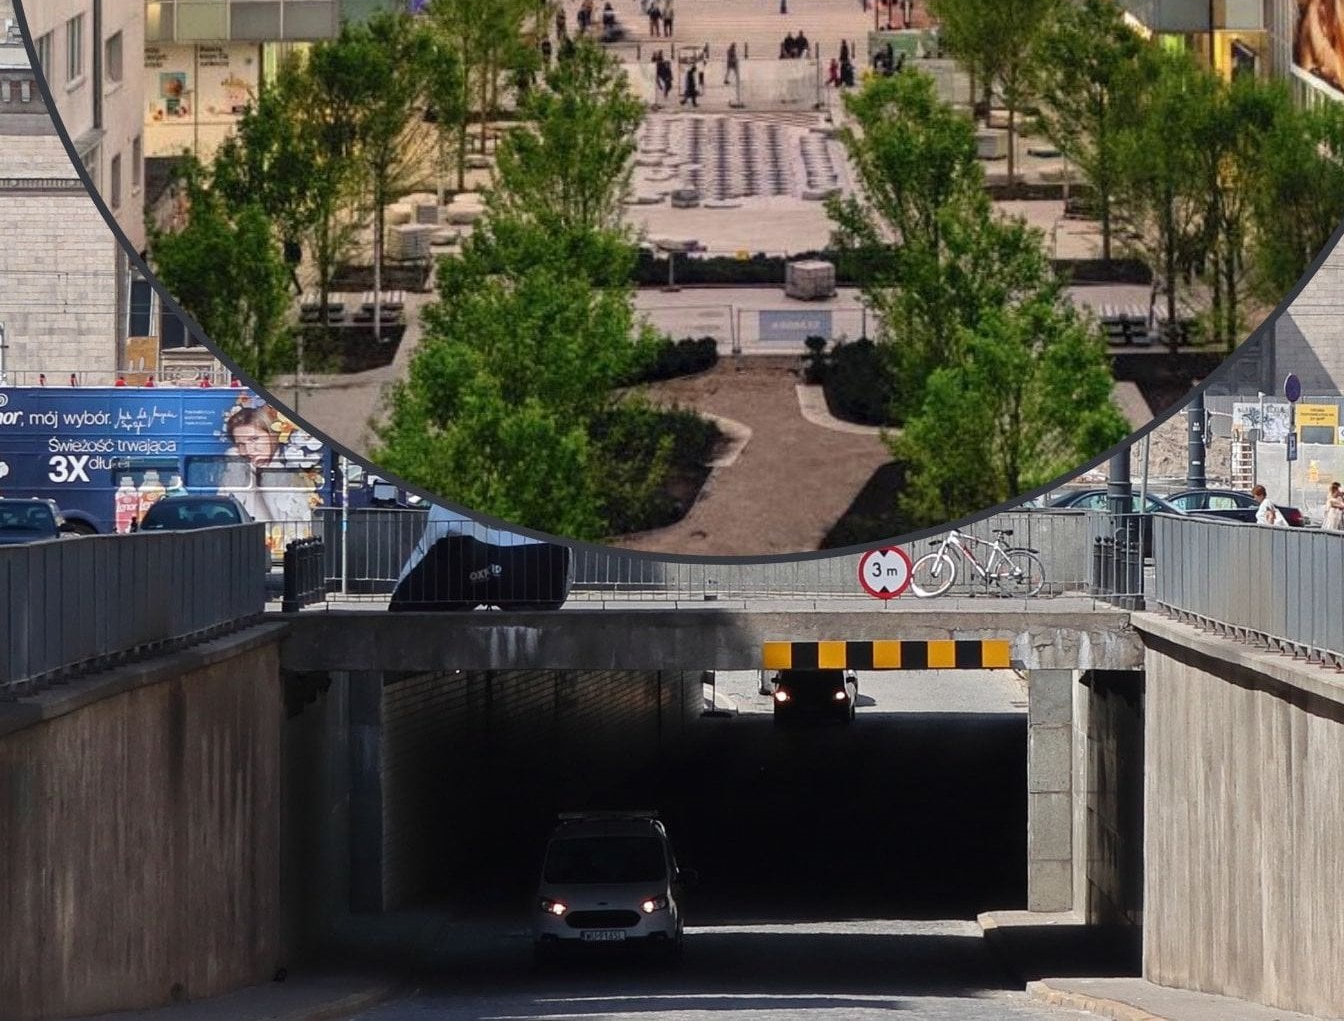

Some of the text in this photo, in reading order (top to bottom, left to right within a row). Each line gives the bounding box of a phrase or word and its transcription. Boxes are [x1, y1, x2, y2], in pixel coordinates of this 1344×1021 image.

[30, 410, 59, 428] mój
[63, 409, 112, 428] wybór.
[48, 436, 176, 455] Świeżość trwająca
[49, 455, 90, 482] 3X
[872, 562, 898, 577] 3 m
